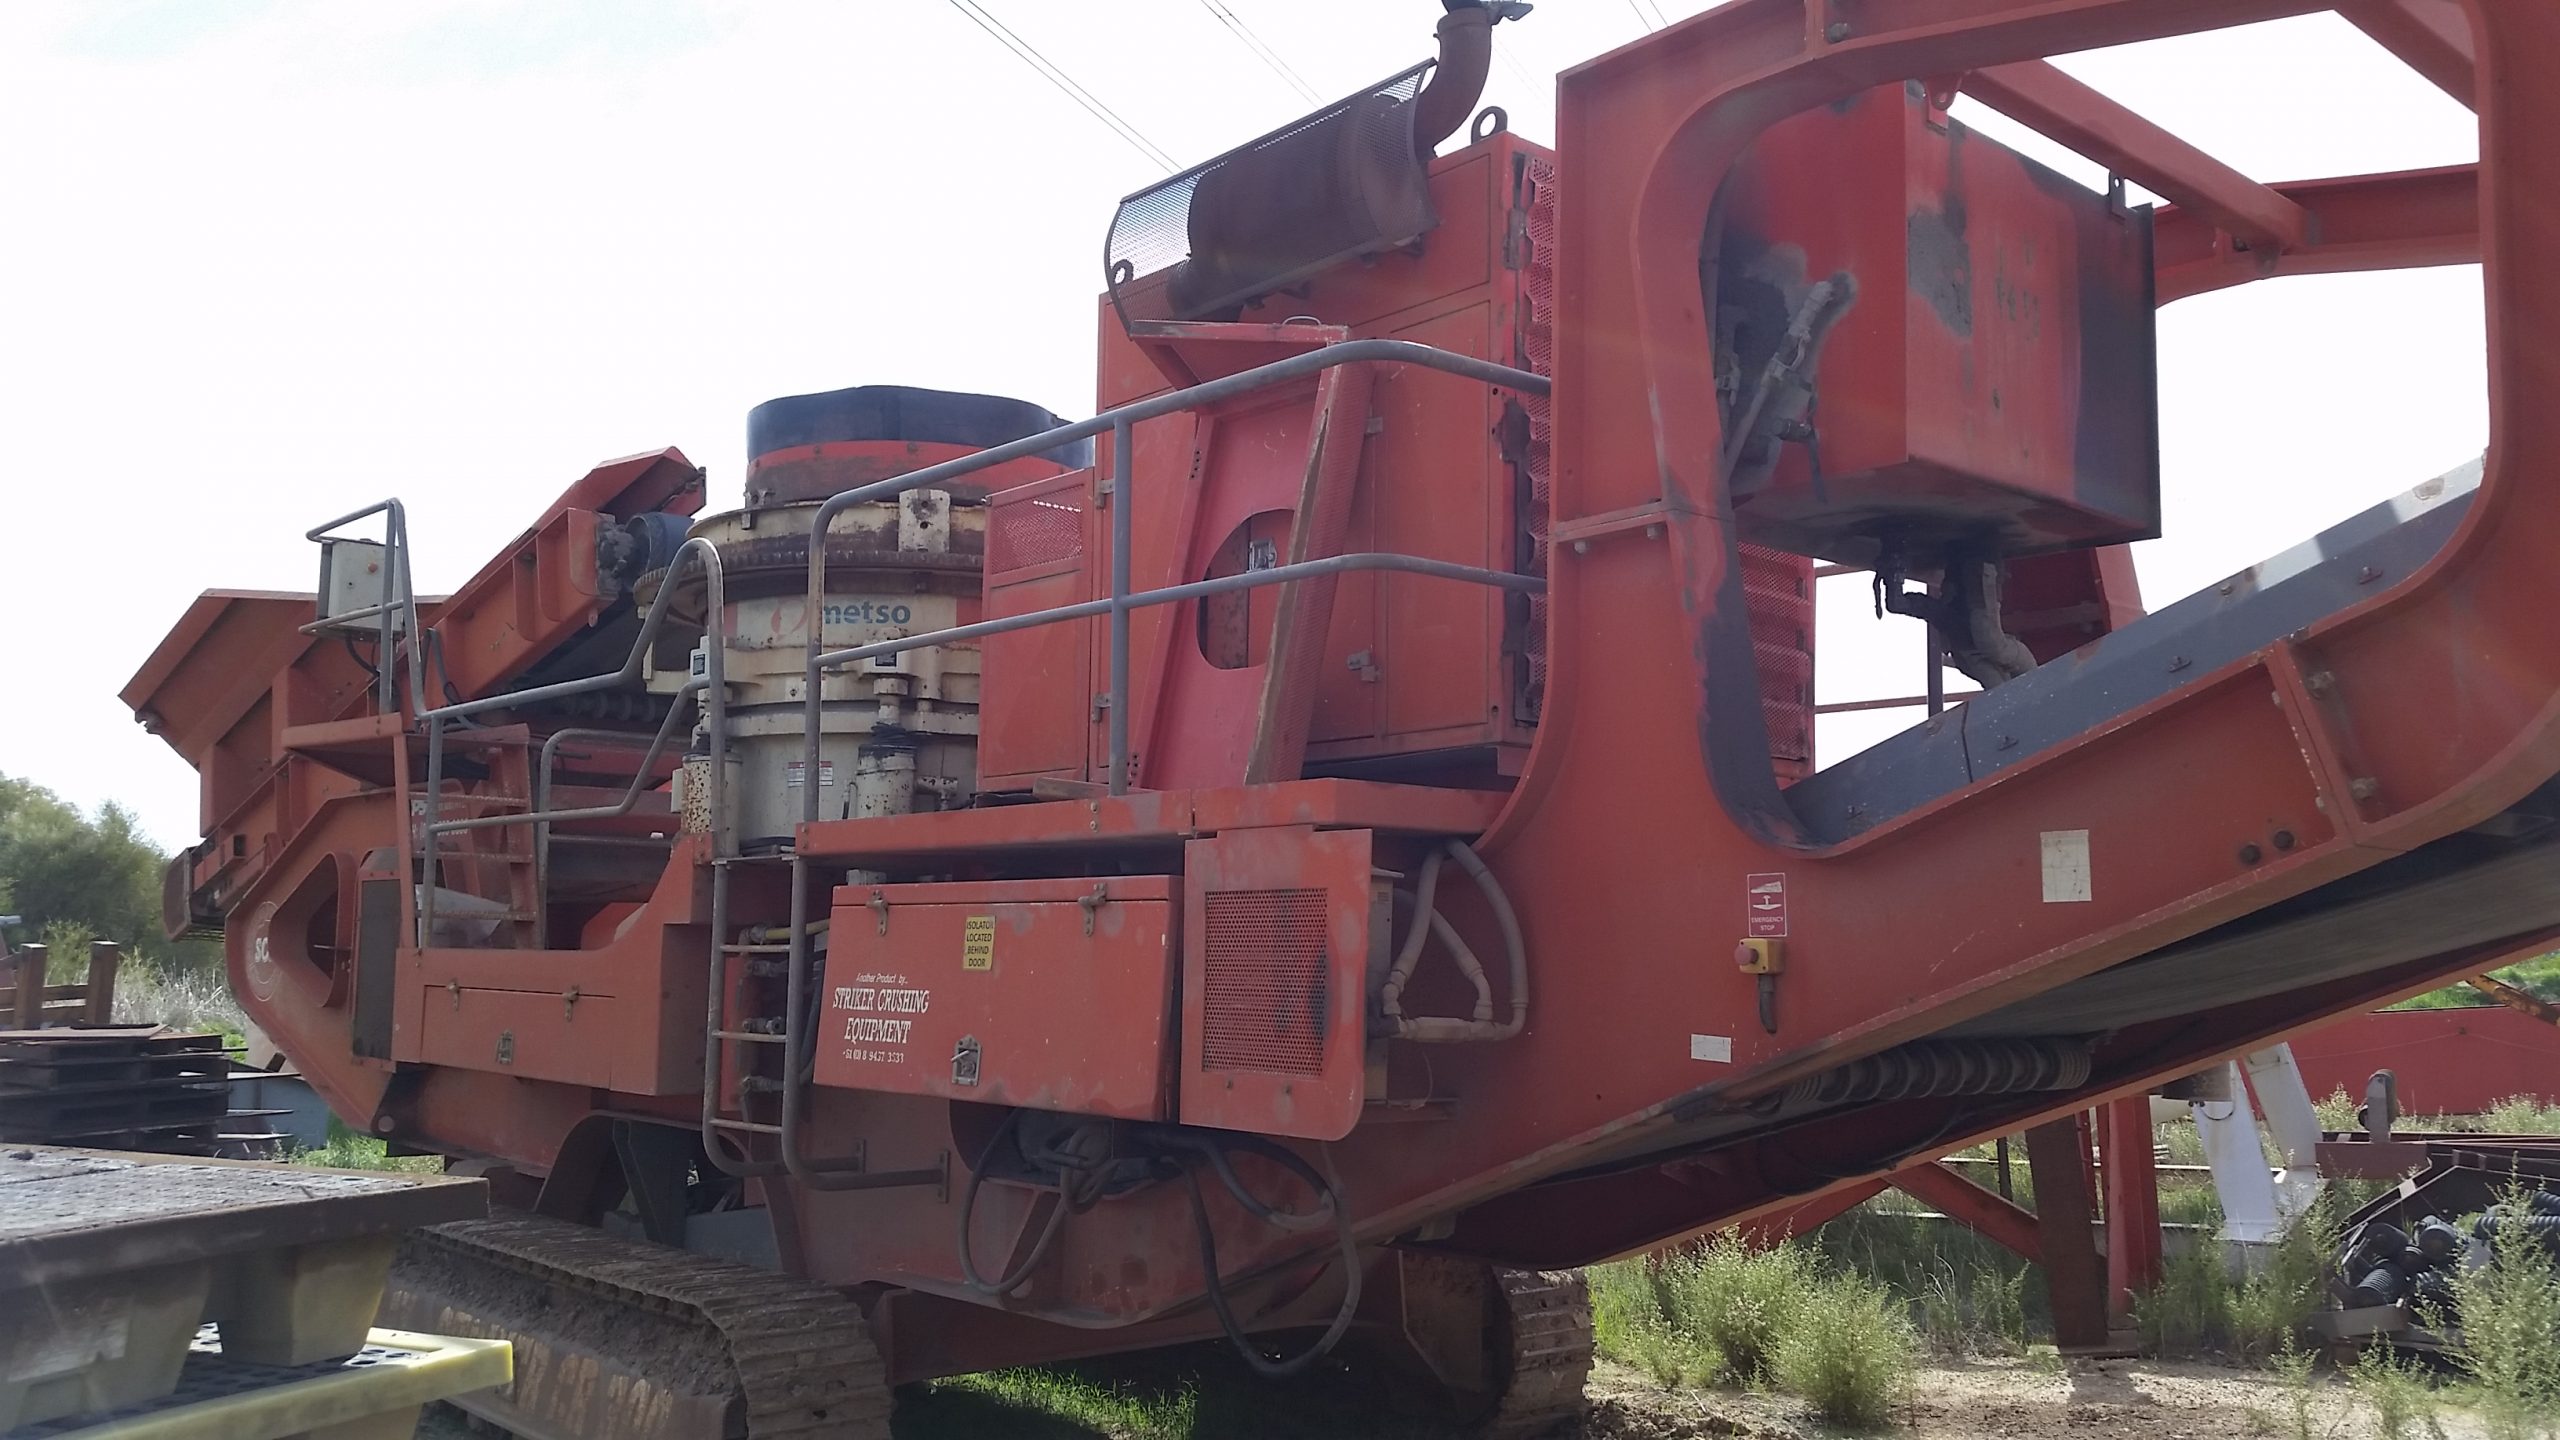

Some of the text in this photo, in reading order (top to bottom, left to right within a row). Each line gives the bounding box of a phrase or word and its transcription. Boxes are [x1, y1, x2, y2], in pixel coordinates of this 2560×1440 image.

[823, 601, 911, 625] metso
[966, 933, 993, 942] LOCATED
[967, 945, 990, 955] BEHIND
[968, 958, 986, 967] DOOR
[856, 973, 876, 983] Another
[876, 973, 897, 984] Product
[832, 987, 930, 1014] STRIKER CRUSHING
[844, 1017, 912, 1045] EQUIPMENT
